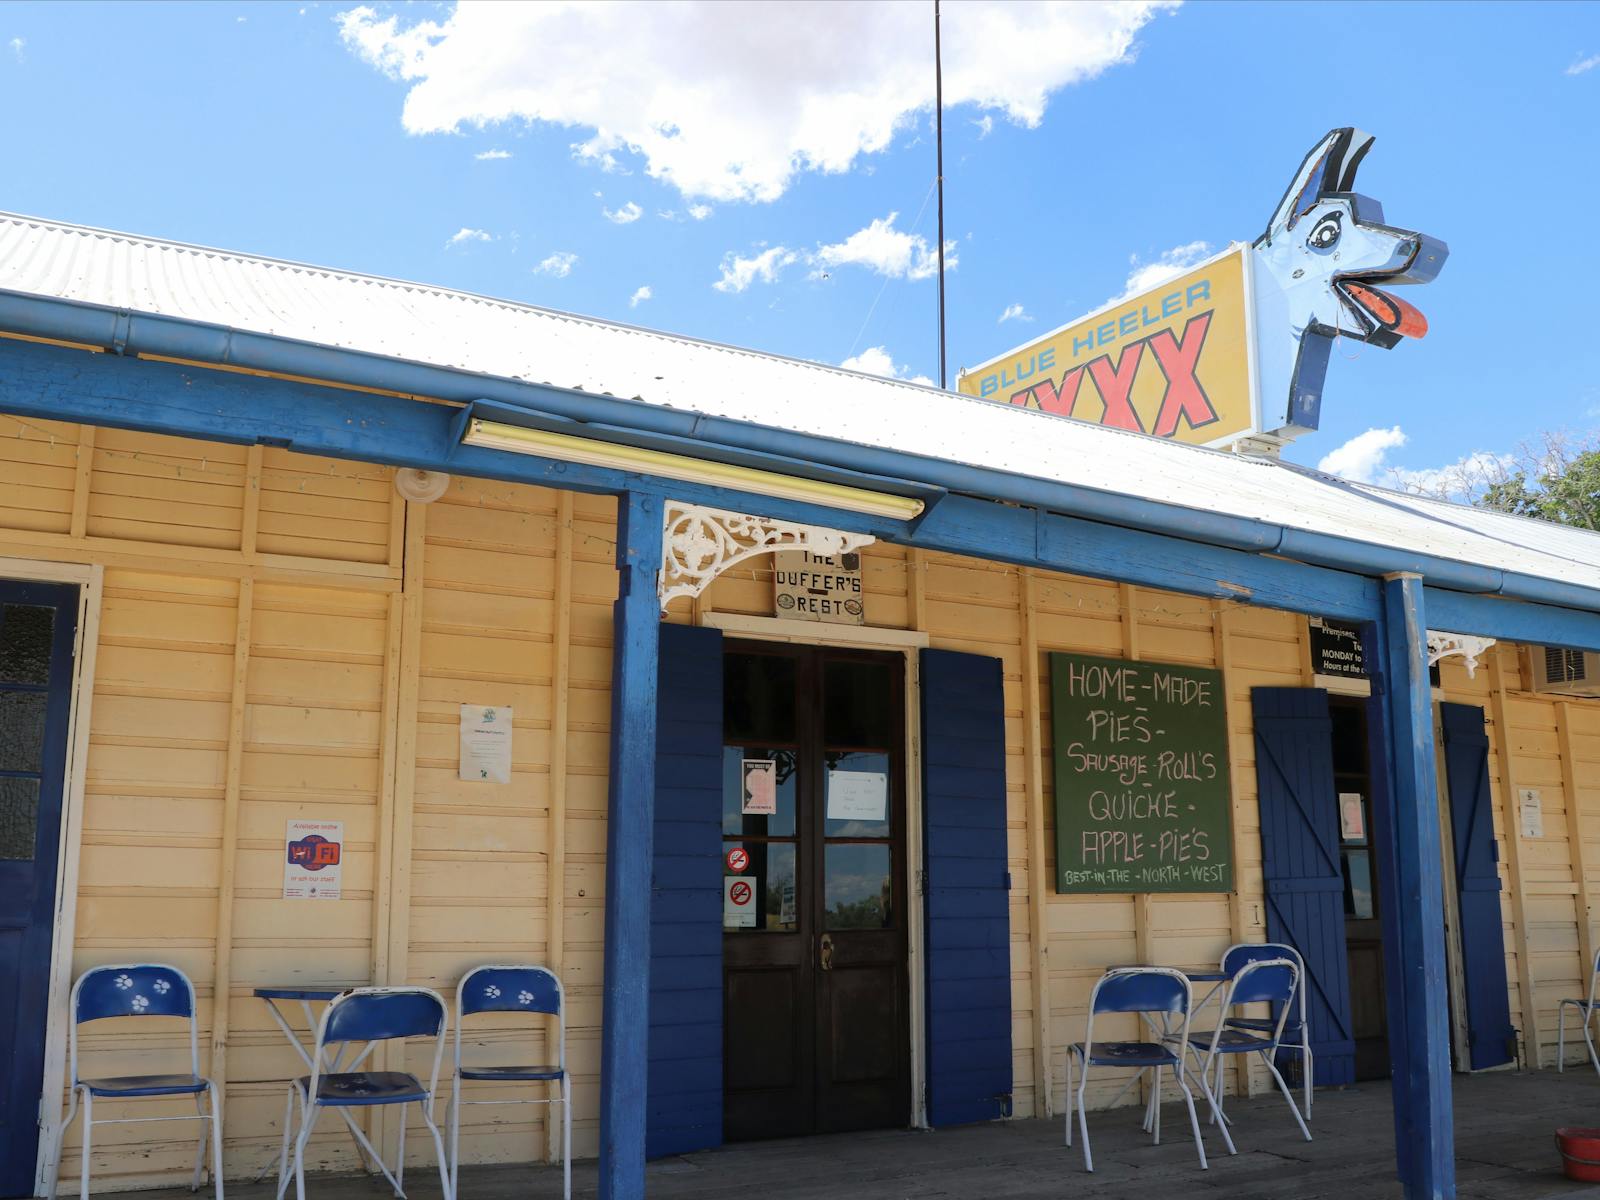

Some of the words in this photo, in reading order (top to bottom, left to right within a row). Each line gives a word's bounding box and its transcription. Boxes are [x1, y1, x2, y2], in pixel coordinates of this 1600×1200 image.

[980, 347, 1055, 397] BLUE
[1072, 279, 1211, 357] HEELER
[1009, 308, 1220, 438] XX
[776, 571, 861, 593] DUFFER'S
[797, 597, 842, 615] REST
[1322, 649, 1353, 661] MONDAY
[1323, 660, 1342, 671] Hours
